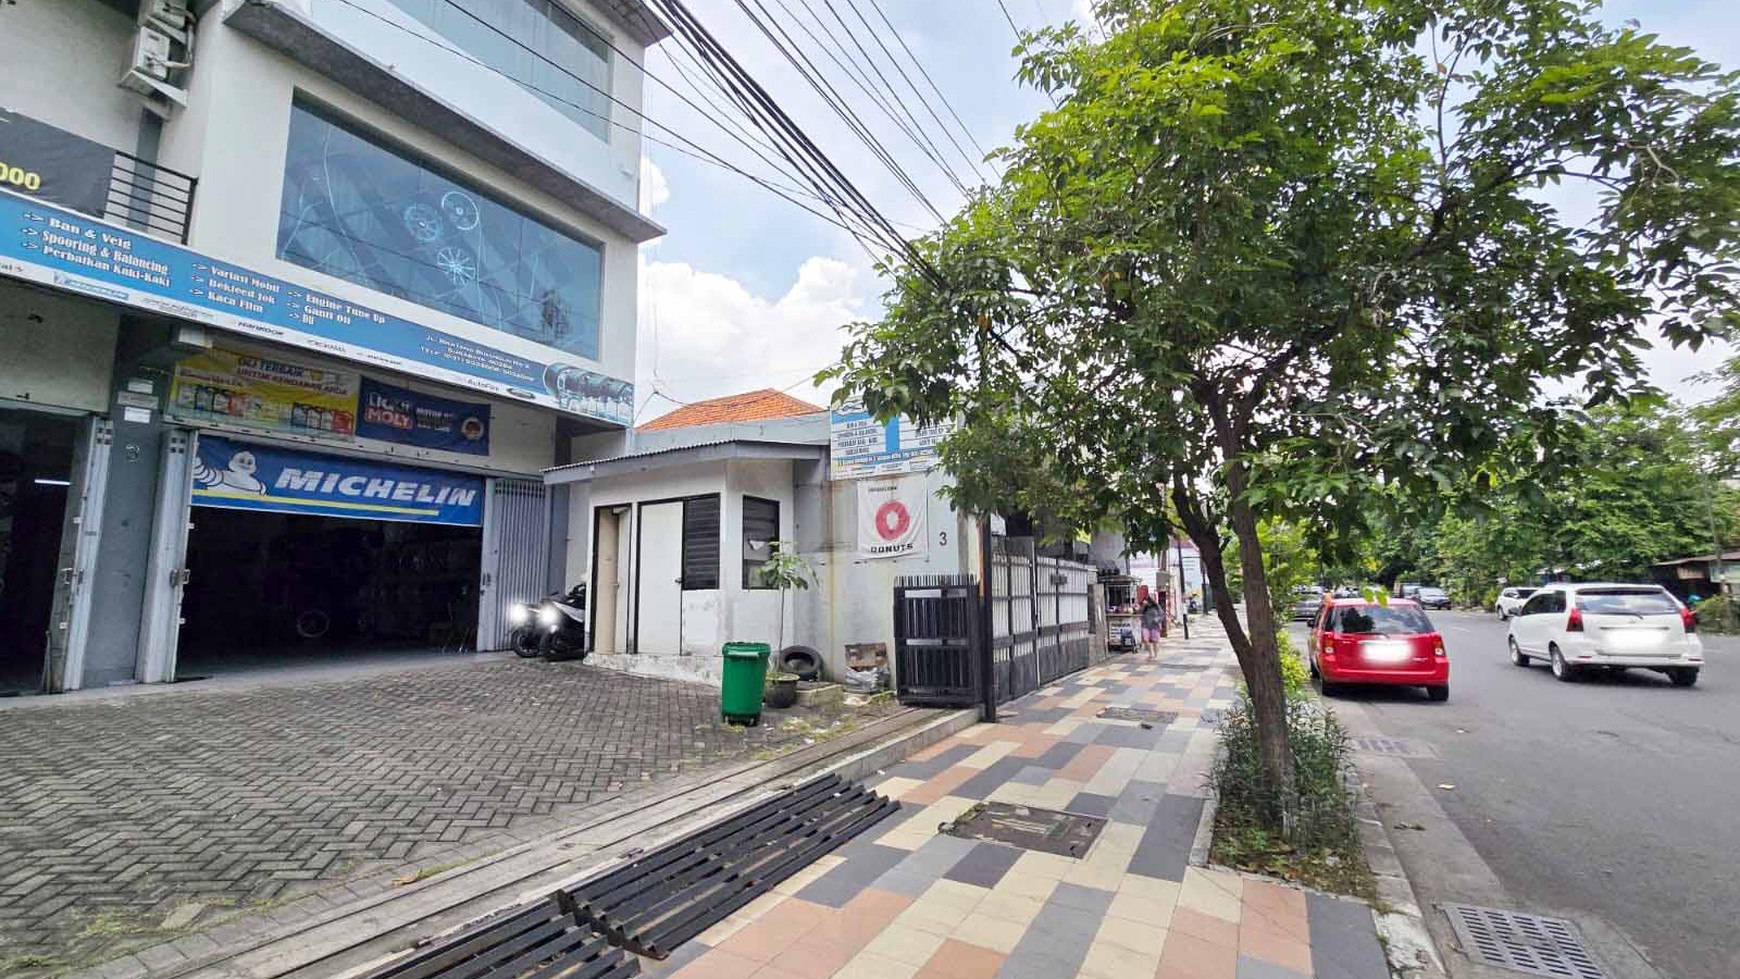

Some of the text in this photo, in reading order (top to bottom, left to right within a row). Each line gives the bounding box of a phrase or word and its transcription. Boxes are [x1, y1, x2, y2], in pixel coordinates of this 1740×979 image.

[49, 218, 132, 250] Ban & Velg
[42, 230, 169, 275] Spooring & Balancing
[43, 245, 110, 271] Perbaikan
[113, 263, 171, 288] Kaki-Kaki
[210, 266, 280, 293] Variasi Mobil
[208, 291, 264, 313] Kaca Film
[304, 305, 334, 320] Ganti
[306, 294, 343, 311] Engine
[346, 305, 371, 319] Tune
[367, 407, 412, 430] MOLY
[275, 467, 478, 508] MICHELIN
[870, 542, 914, 554] DONUTS
[939, 531, 948, 546] 3
